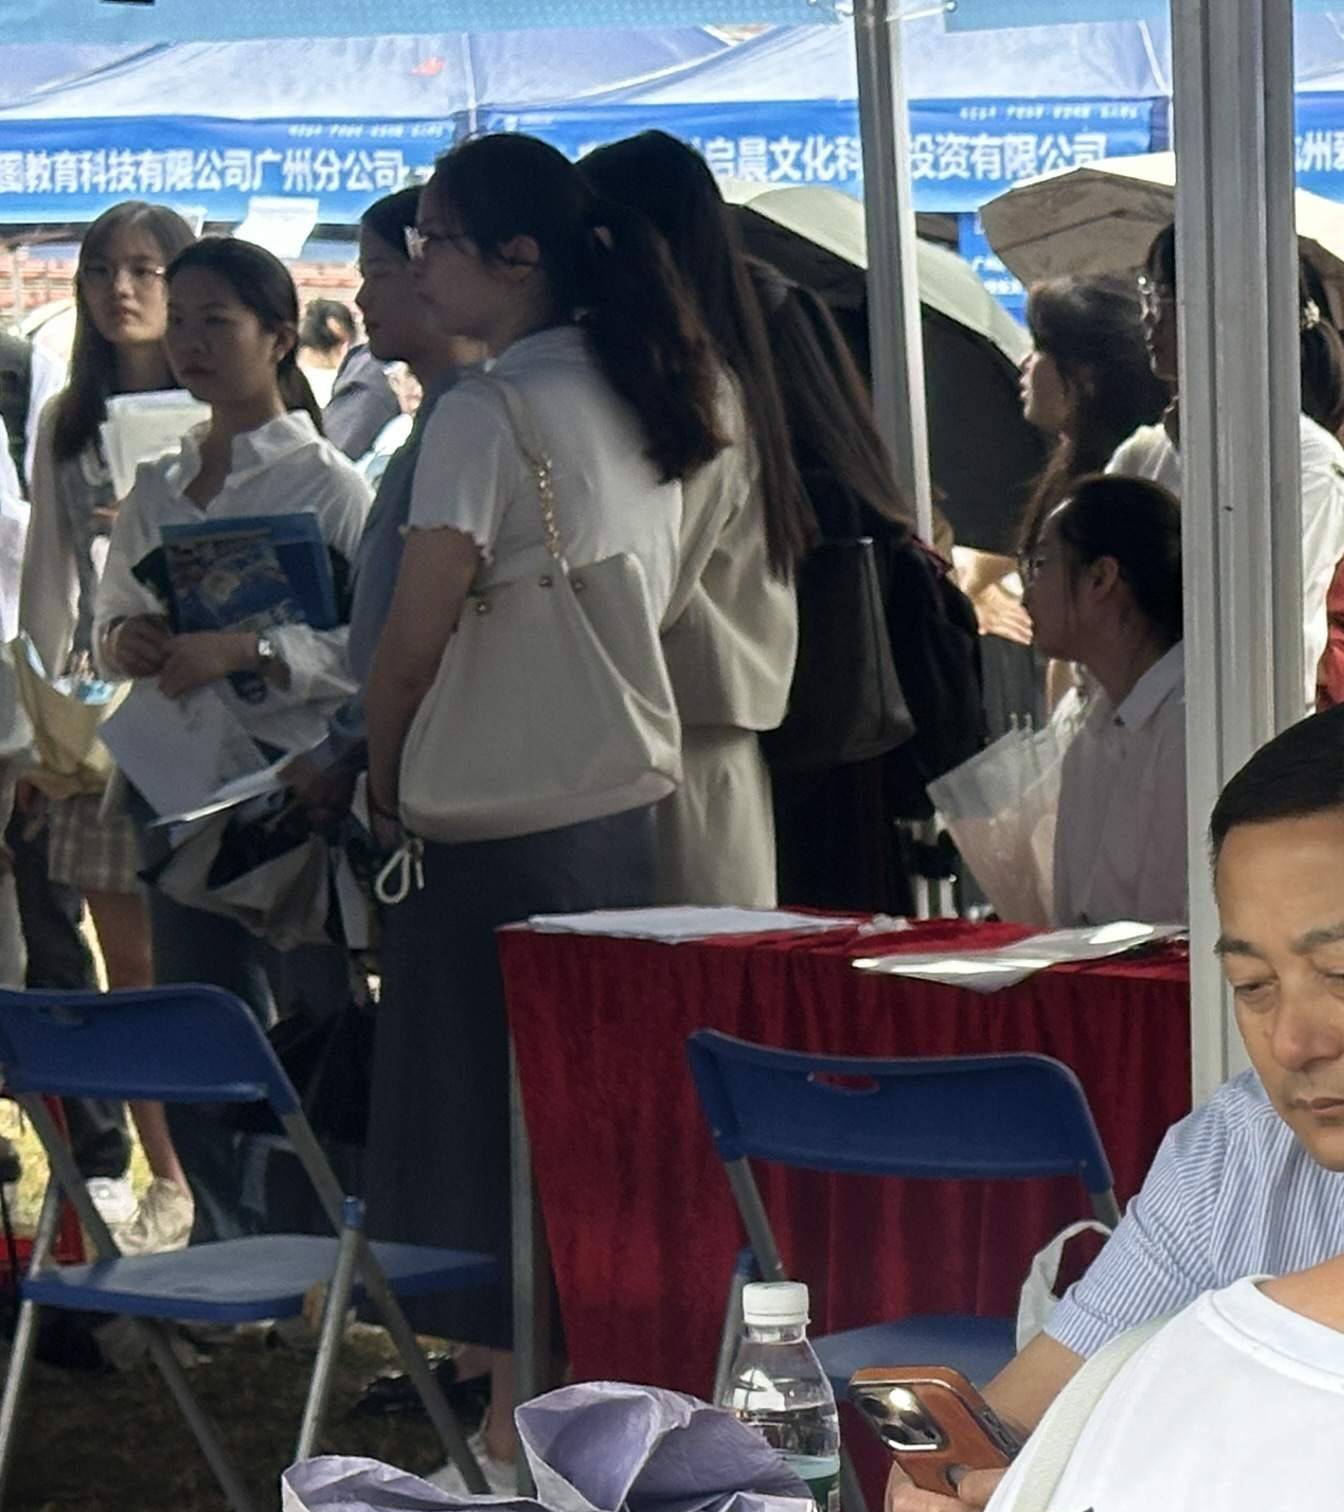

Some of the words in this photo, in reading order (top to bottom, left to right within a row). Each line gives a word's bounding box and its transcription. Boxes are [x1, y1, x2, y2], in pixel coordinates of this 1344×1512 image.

[692, 132, 1106, 182] 启晨文化科投资有限公司
